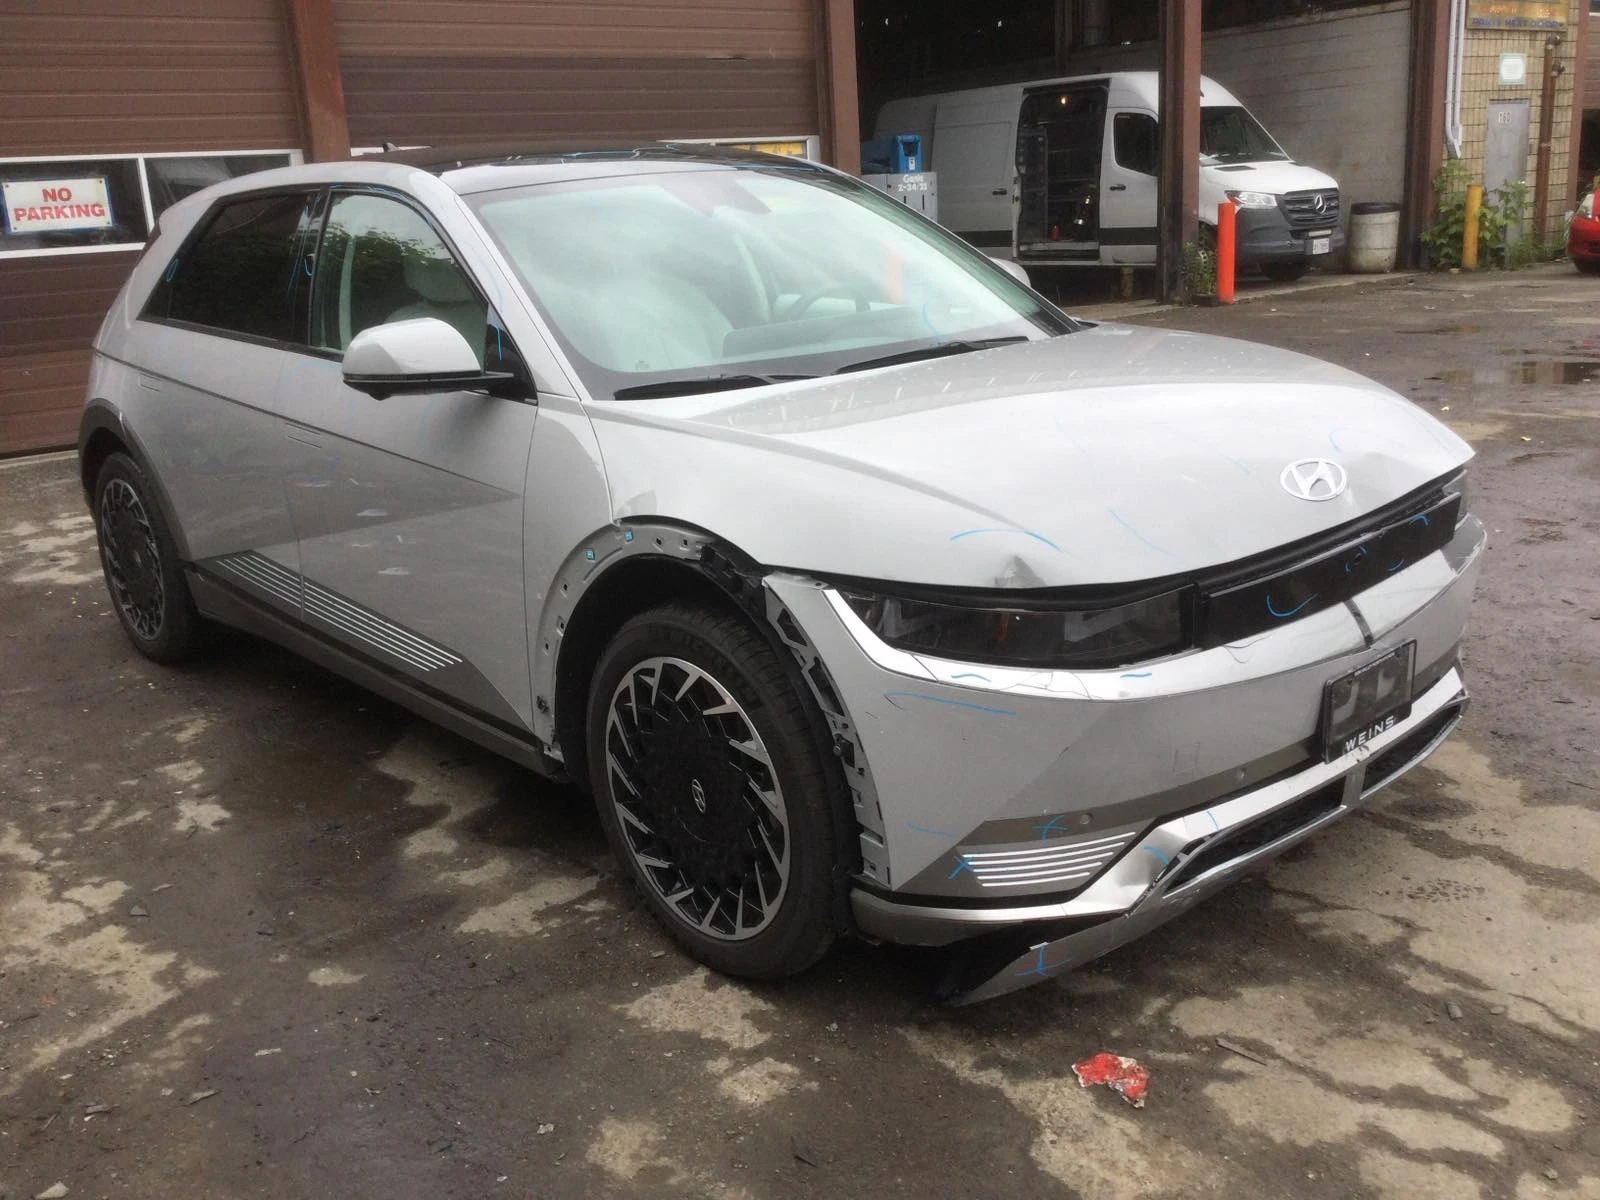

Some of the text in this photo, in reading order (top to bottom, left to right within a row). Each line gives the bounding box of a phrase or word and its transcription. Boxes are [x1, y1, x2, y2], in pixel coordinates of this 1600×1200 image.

[42, 187, 73, 202] NO
[13, 203, 105, 221] PARKING
[1345, 715, 1395, 751] WEINS
